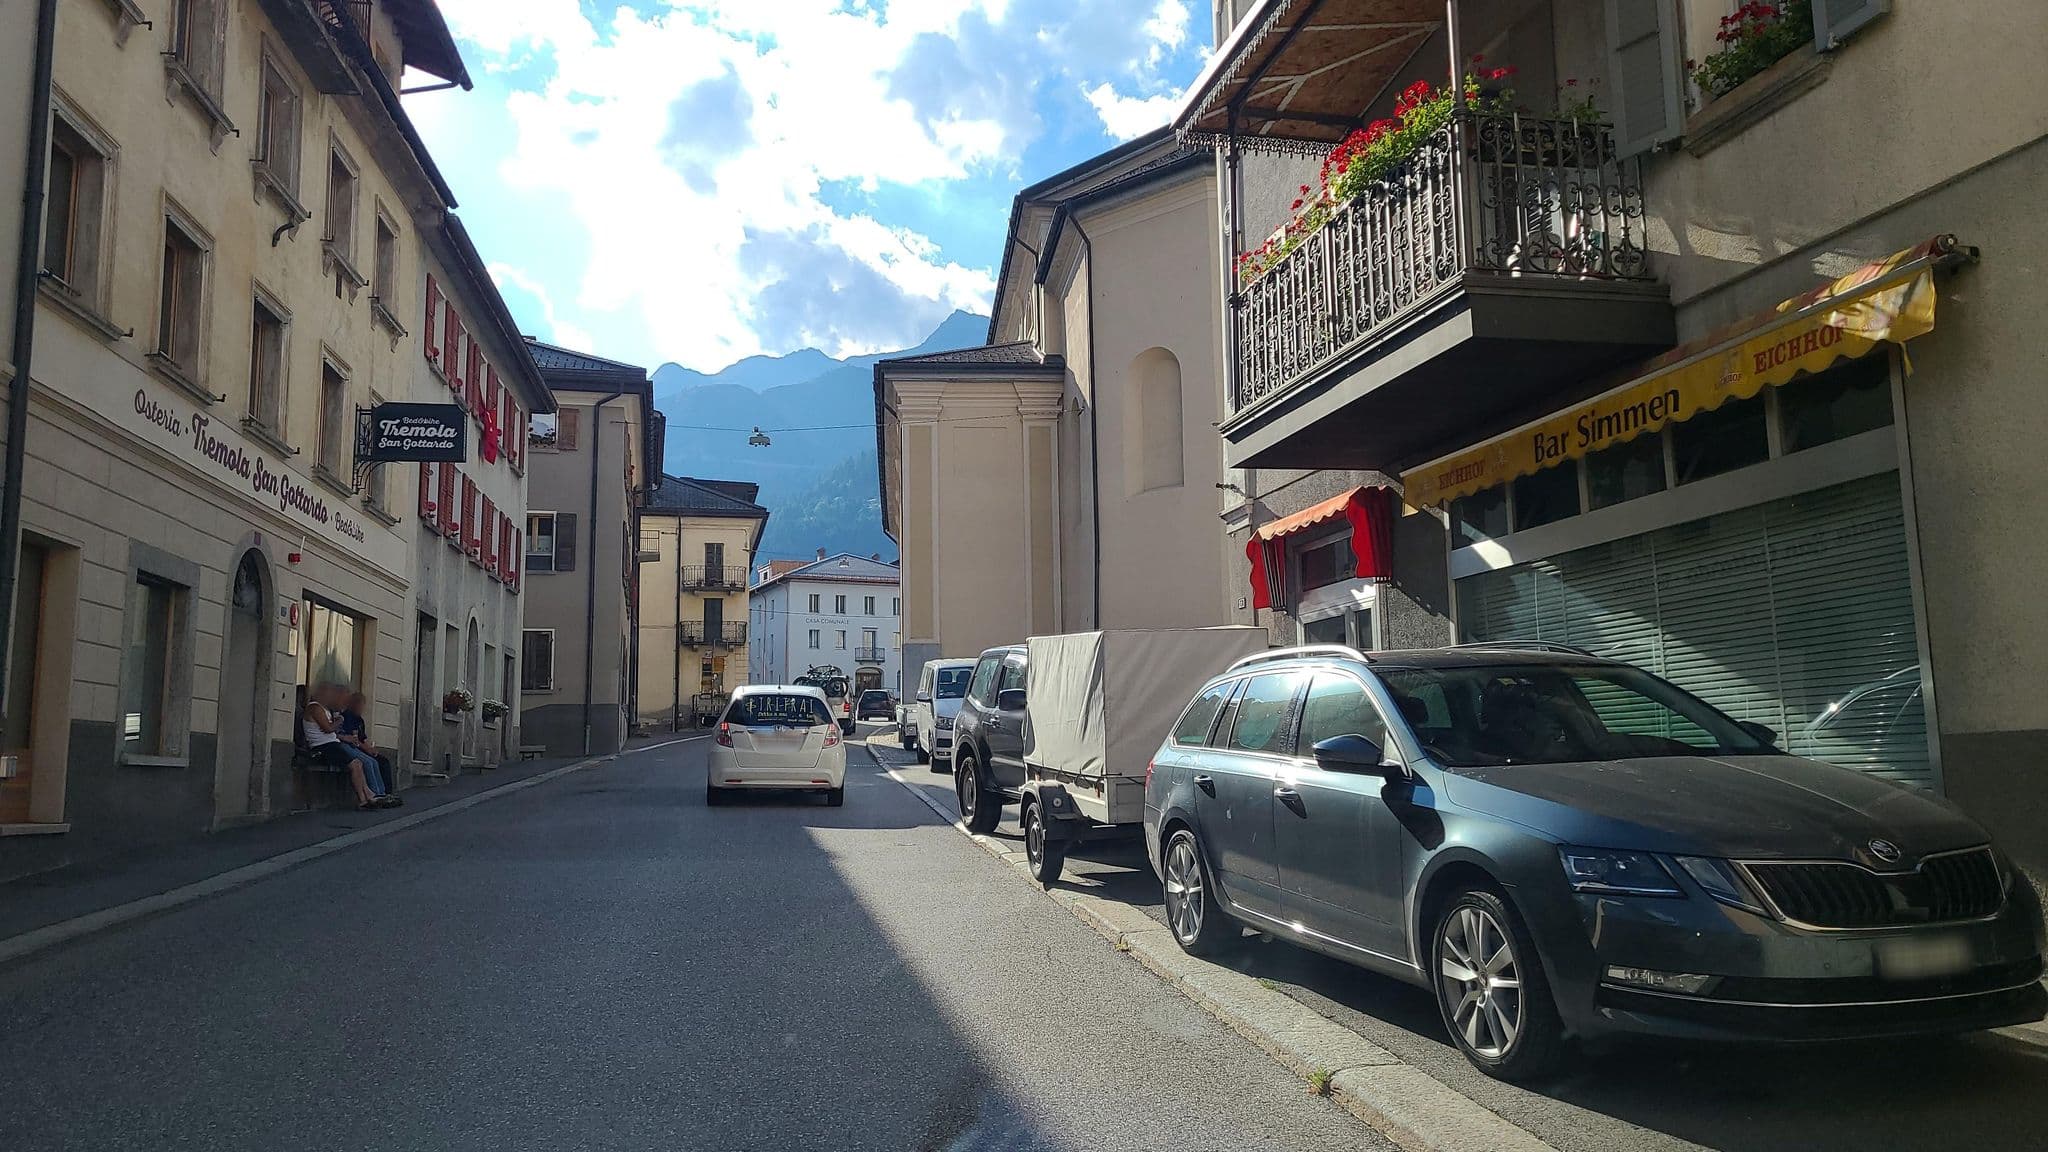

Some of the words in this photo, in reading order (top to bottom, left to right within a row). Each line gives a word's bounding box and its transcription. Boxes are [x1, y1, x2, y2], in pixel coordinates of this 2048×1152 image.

[1753, 324, 1845, 375] EICHHOF
[378, 437, 402, 449] San
[402, 438, 455, 451] Gottardo
[379, 418, 458, 438] Tremola
[1533, 431, 1569, 464] Bar
[1577, 388, 1680, 448] Simmen
[134, 388, 181, 437] Osteria
[192, 412, 251, 479] Tremola
[253, 456, 279, 496] San
[280, 474, 329, 524] Gottardo
[1438, 456, 1486, 490] EICHHOF
